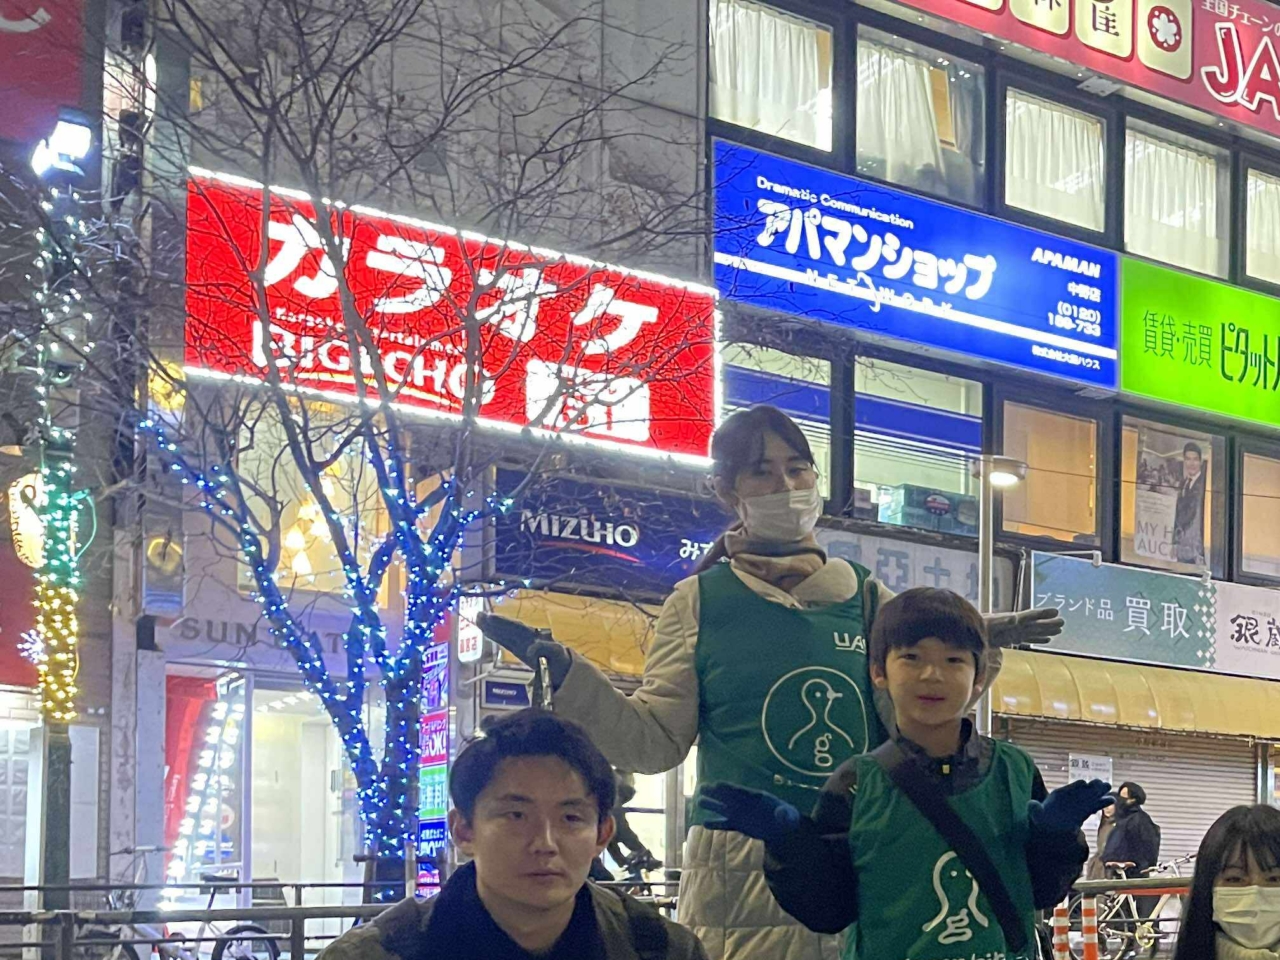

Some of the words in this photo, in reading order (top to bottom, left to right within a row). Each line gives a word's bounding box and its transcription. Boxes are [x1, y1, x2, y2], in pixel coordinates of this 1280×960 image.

[757, 175, 818, 204] Dramatic
[820, 193, 915, 230] Communication
[756, 198, 997, 300] アパマンショップ
[1031, 247, 1101, 279] APAMAN
[264, 213, 660, 355] カラオケ
[520, 508, 640, 548] MIZUHO
[1136, 519, 1159, 537] MY
[179, 616, 257, 646] SUN
[1035, 591, 1114, 621] ブランド品
[1122, 595, 1190, 639] 買取
[833, 631, 867, 653] UA
[814, 732, 833, 767] g
[938, 907, 974, 945] g
